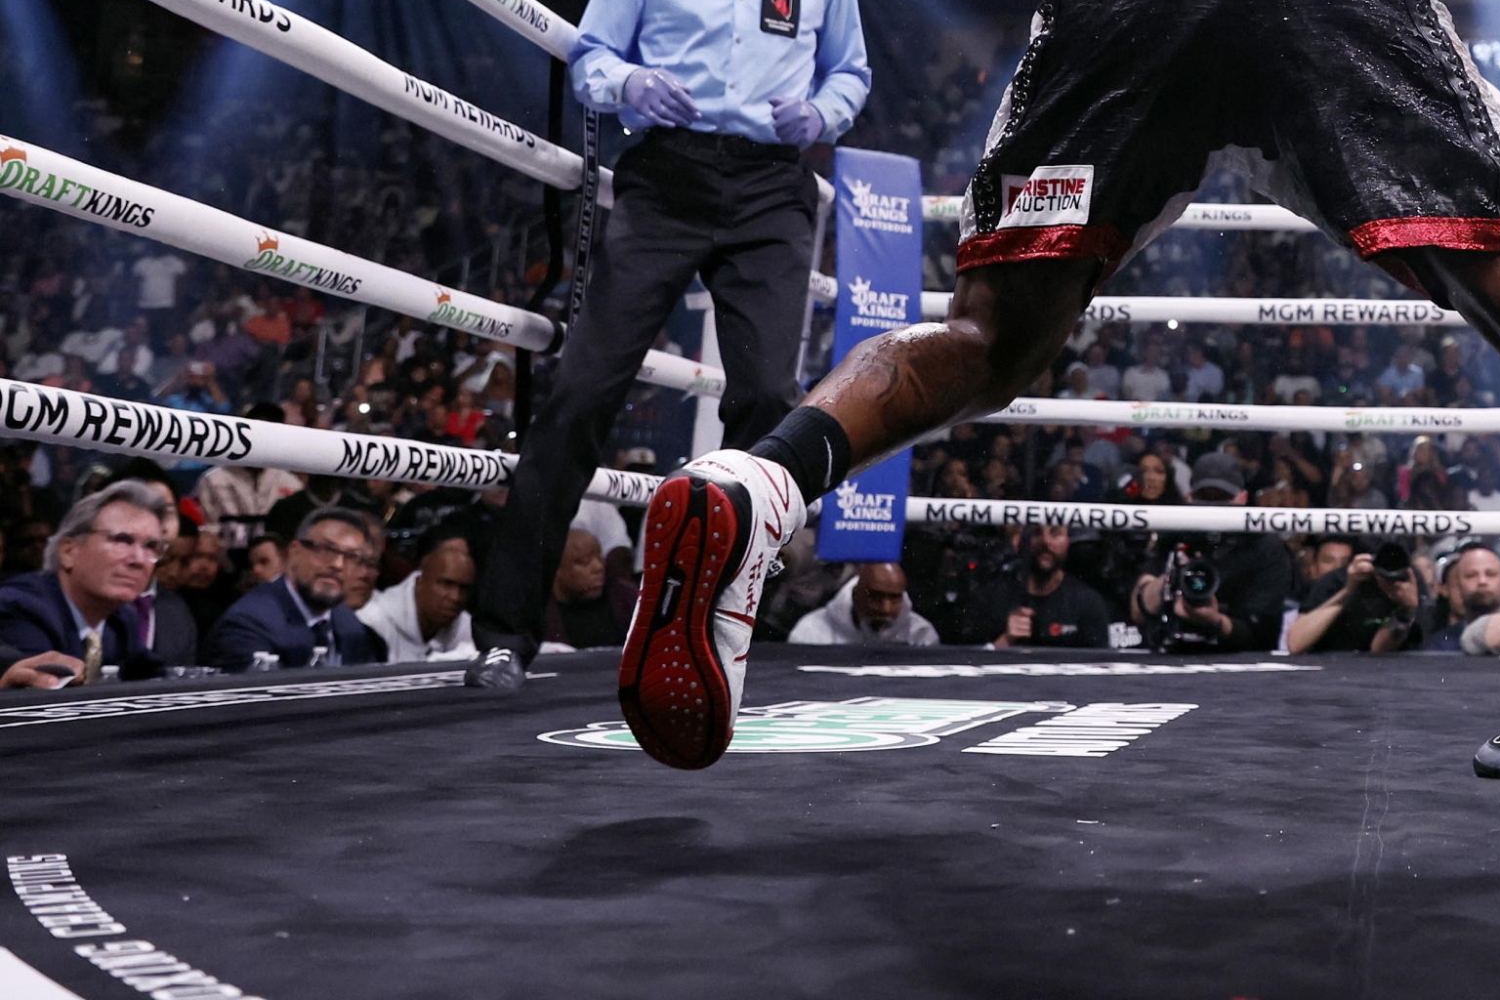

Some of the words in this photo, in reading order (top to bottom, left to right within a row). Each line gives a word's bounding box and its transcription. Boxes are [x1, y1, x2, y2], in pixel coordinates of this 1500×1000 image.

[0, 160, 155, 228] DRAFTKINGS
[1013, 194, 1082, 212] AUCTION
[853, 218, 913, 234] SPORTSBOOK
[857, 206, 909, 223] KINGS
[244, 248, 362, 296] DRAFTKINGS
[430, 301, 513, 339] DRAFTKINGS
[857, 304, 907, 320] KINGS
[1258, 303, 1318, 321] MGM
[1323, 303, 1444, 321] REWARDS
[0, 384, 69, 434] GM
[74, 395, 253, 461] REWARDS
[336, 438, 400, 477] MGM
[843, 505, 892, 521] KINGS
[926, 504, 992, 526] MGM
[1003, 506, 1149, 530] REWARDS
[1245, 511, 1312, 532] MGM
[1324, 512, 1472, 534] REWARDS
[74, 940, 267, 1000] OXING
